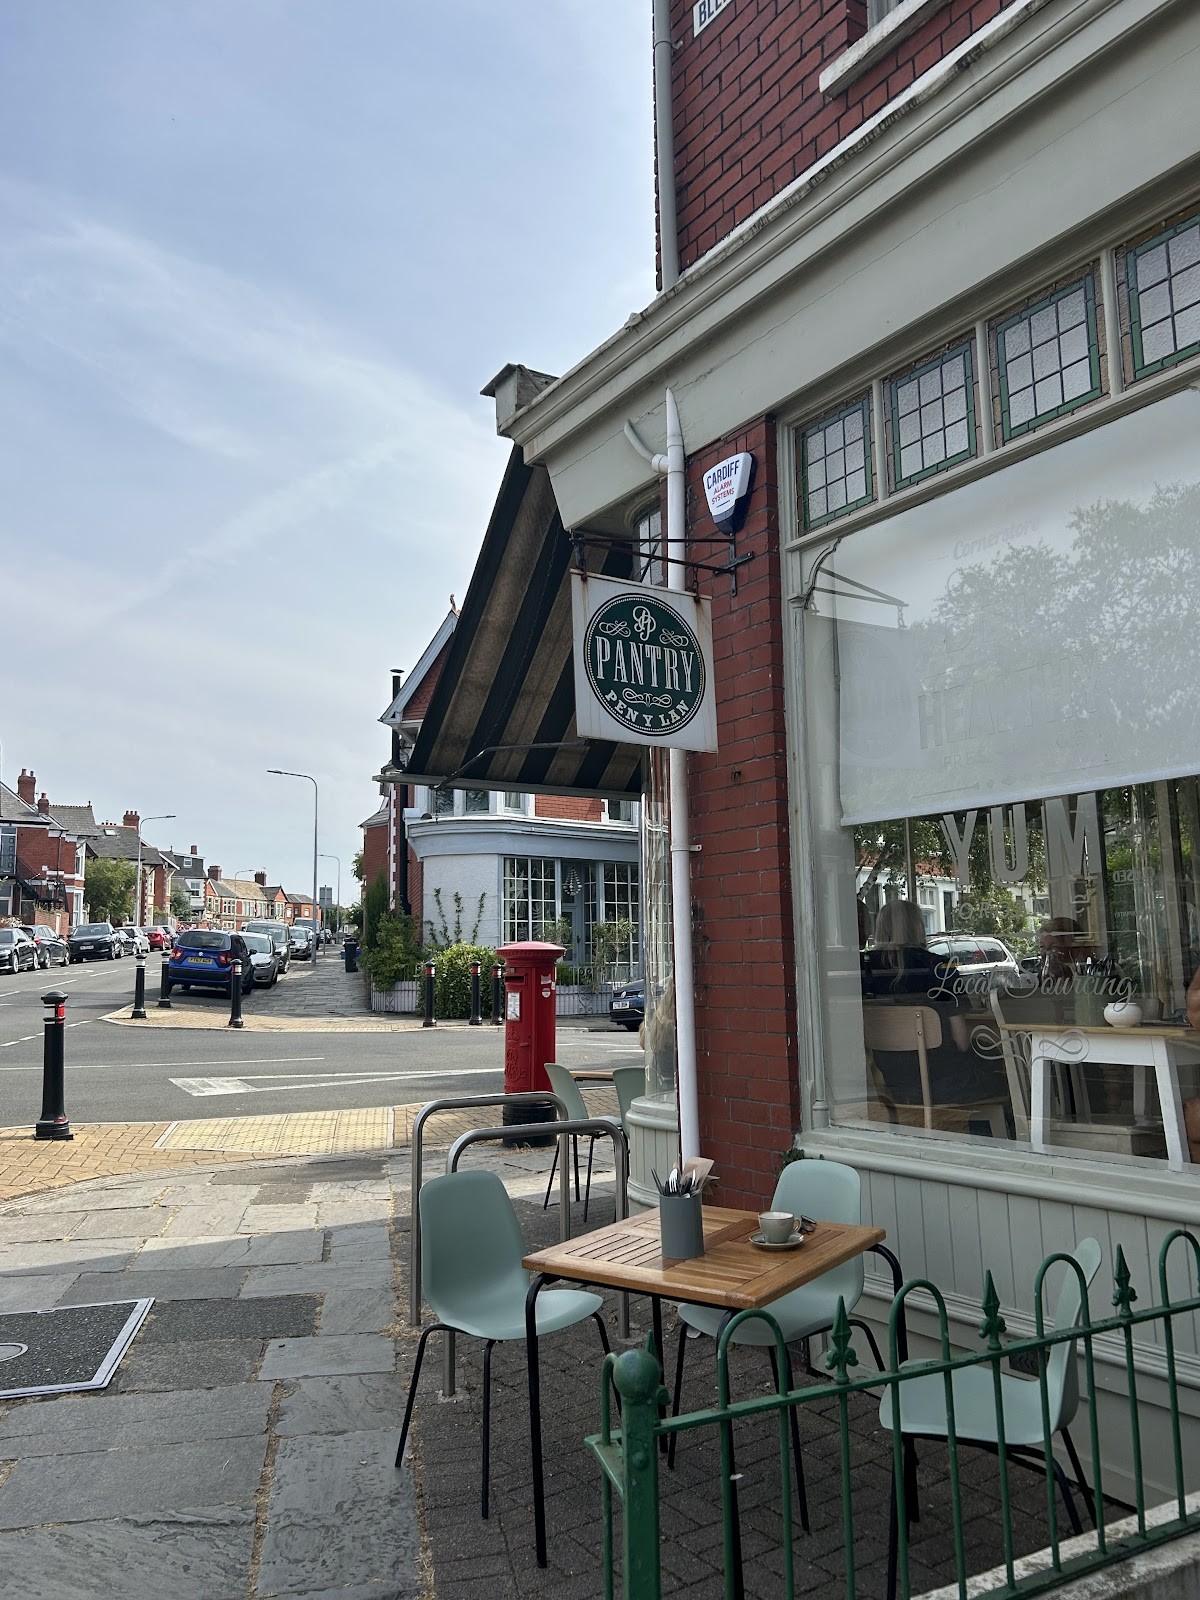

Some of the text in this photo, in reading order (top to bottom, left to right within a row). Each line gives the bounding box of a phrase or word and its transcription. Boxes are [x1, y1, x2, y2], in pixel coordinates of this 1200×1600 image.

[706, 460, 740, 490] CARDIFF
[713, 480, 733, 495] ALARM
[711, 488, 735, 505] SYSTEMS
[595, 635, 695, 693] PANTRY
[605, 689, 690, 727] PEN Y LAN
[941, 792, 1101, 885] YUM
[959, 894, 1085, 920] ORGANC
[927, 956, 1137, 1012] Local Sourcing
